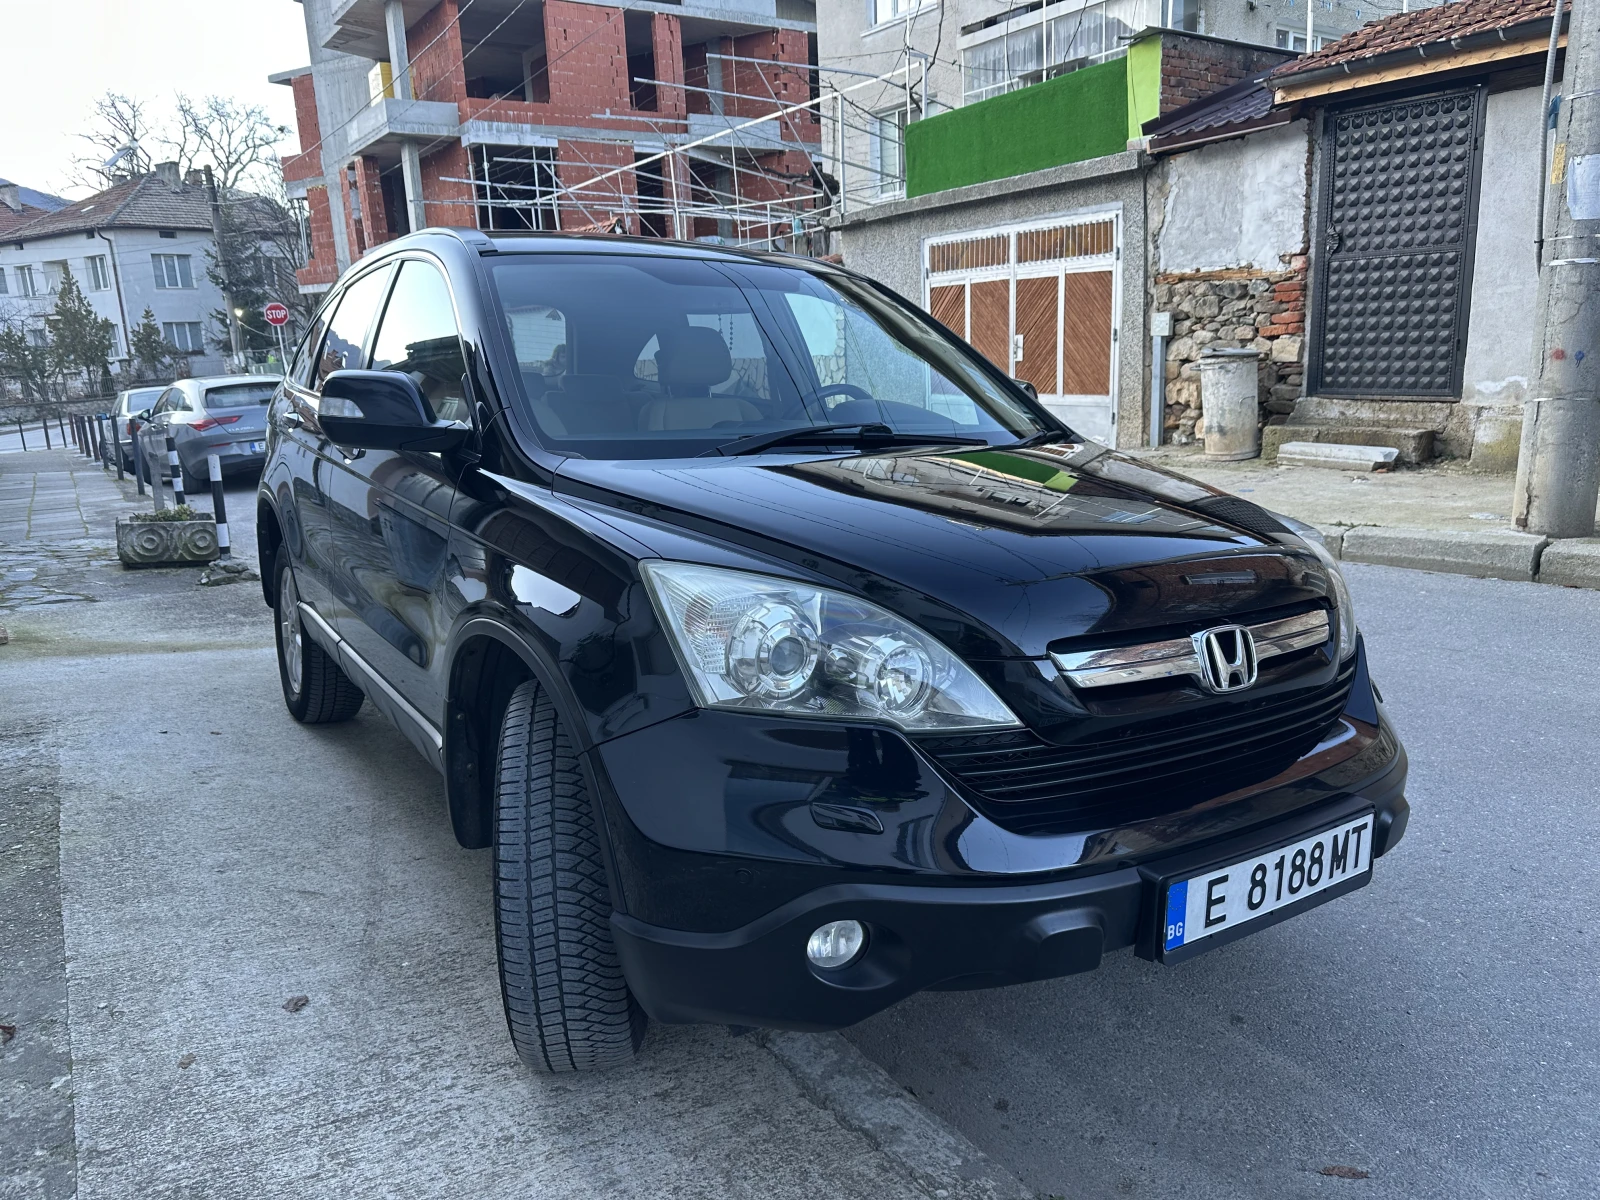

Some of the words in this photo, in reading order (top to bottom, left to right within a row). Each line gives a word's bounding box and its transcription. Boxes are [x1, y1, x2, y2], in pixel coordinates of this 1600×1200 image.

[266, 309, 286, 319] STOP
[1205, 873, 1229, 928] E
[1167, 922, 1183, 940] BG
